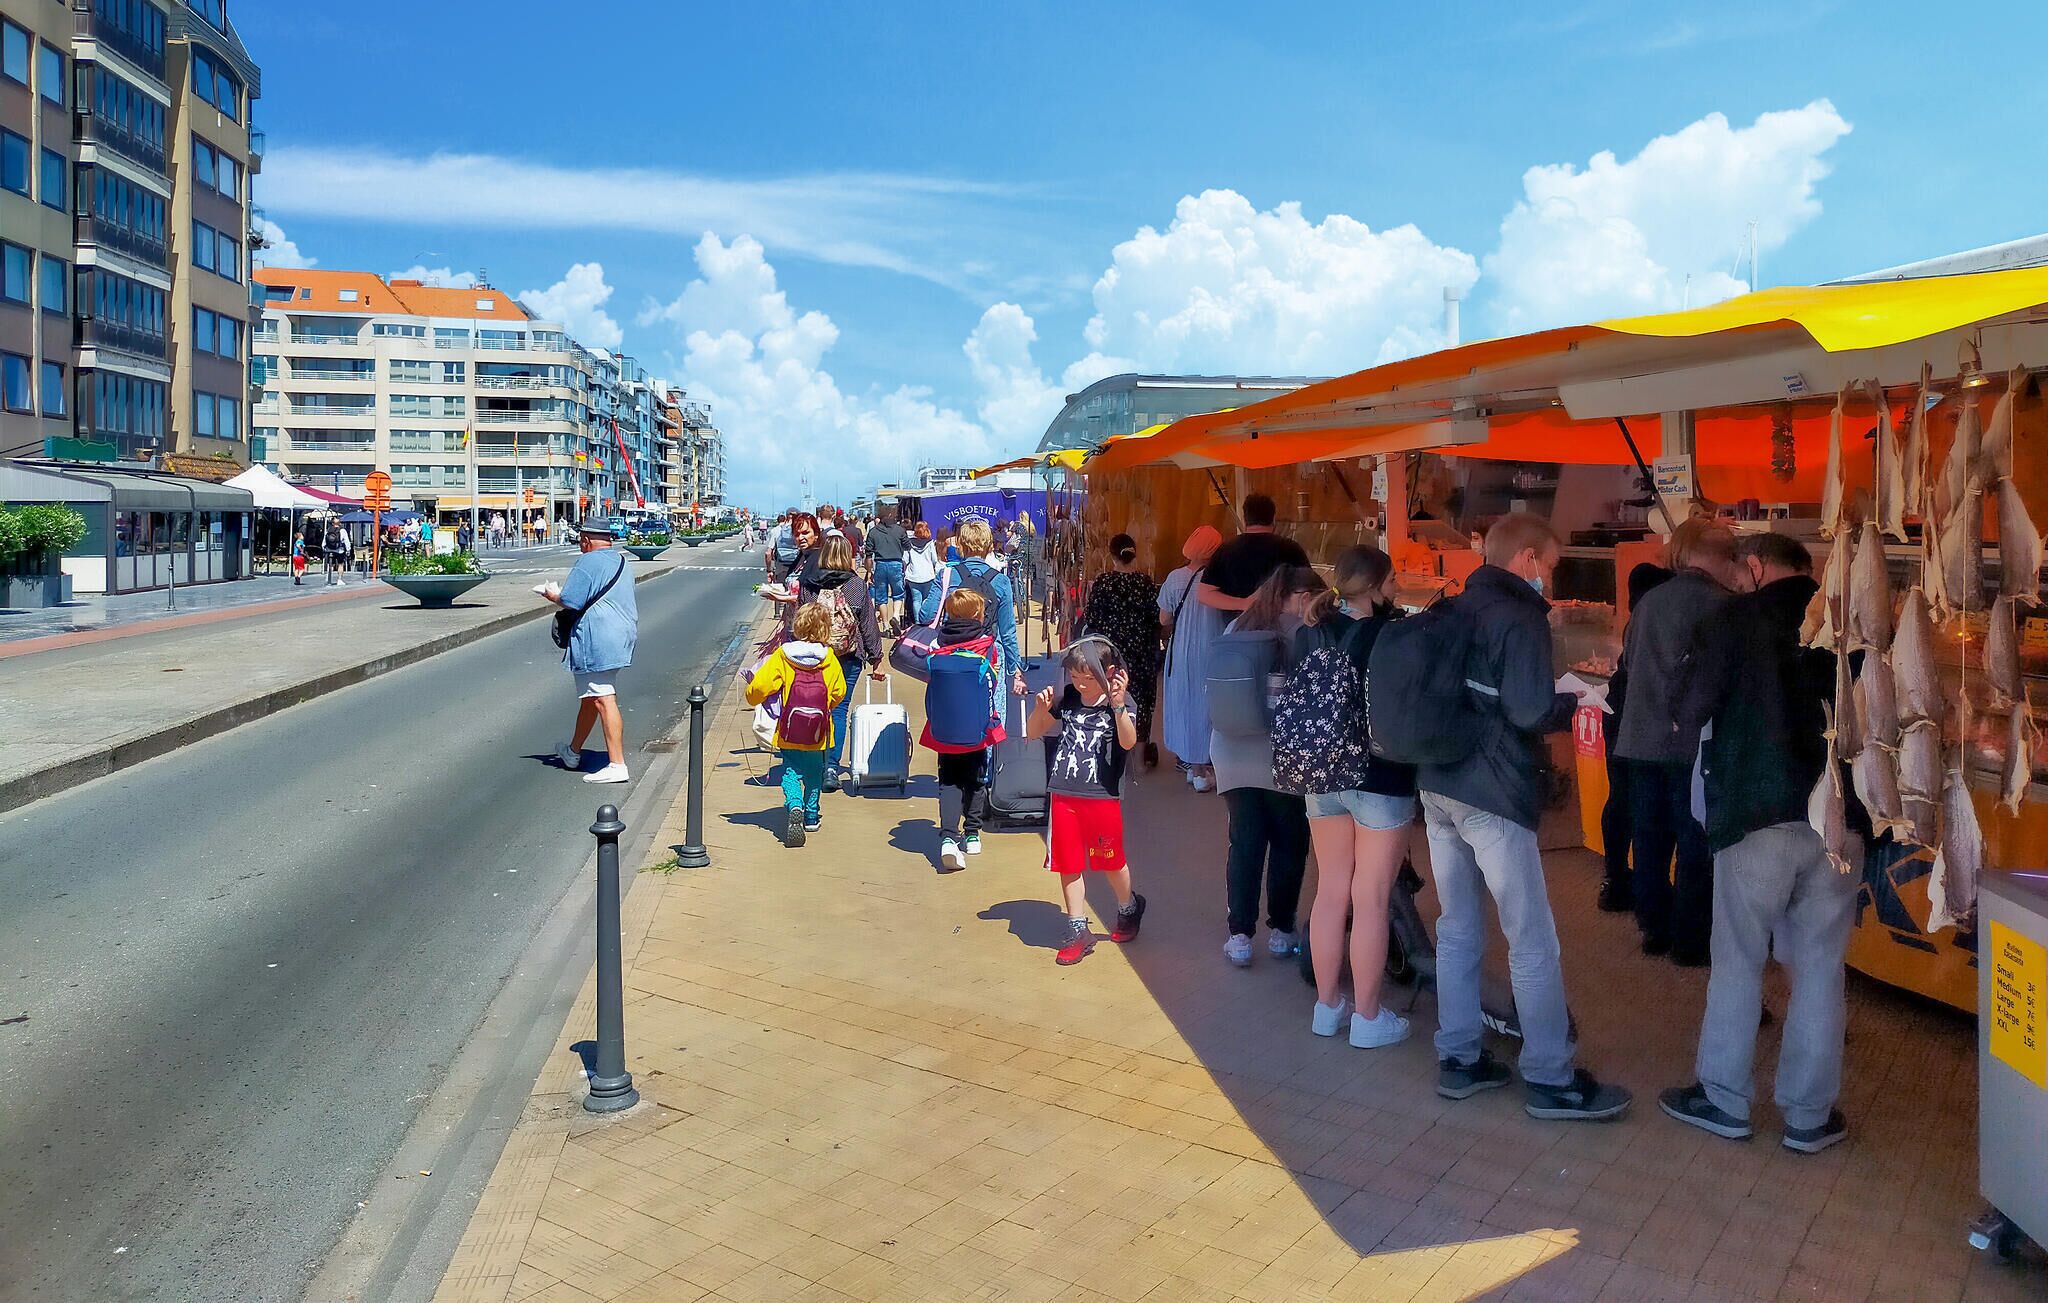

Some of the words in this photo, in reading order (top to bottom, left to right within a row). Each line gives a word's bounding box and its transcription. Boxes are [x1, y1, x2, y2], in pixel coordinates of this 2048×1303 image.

[1657, 465, 1687, 473] Bancontact
[1674, 485, 1688, 493] Cash
[943, 505, 999, 521] VISBOETIEK
[1997, 963, 2015, 981] Small
[1997, 977, 2022, 1000] Medium
[1997, 990, 2015, 1009] Large
[1997, 1004, 2020, 1026] X-large
[1997, 1017, 2009, 1033] XXL
